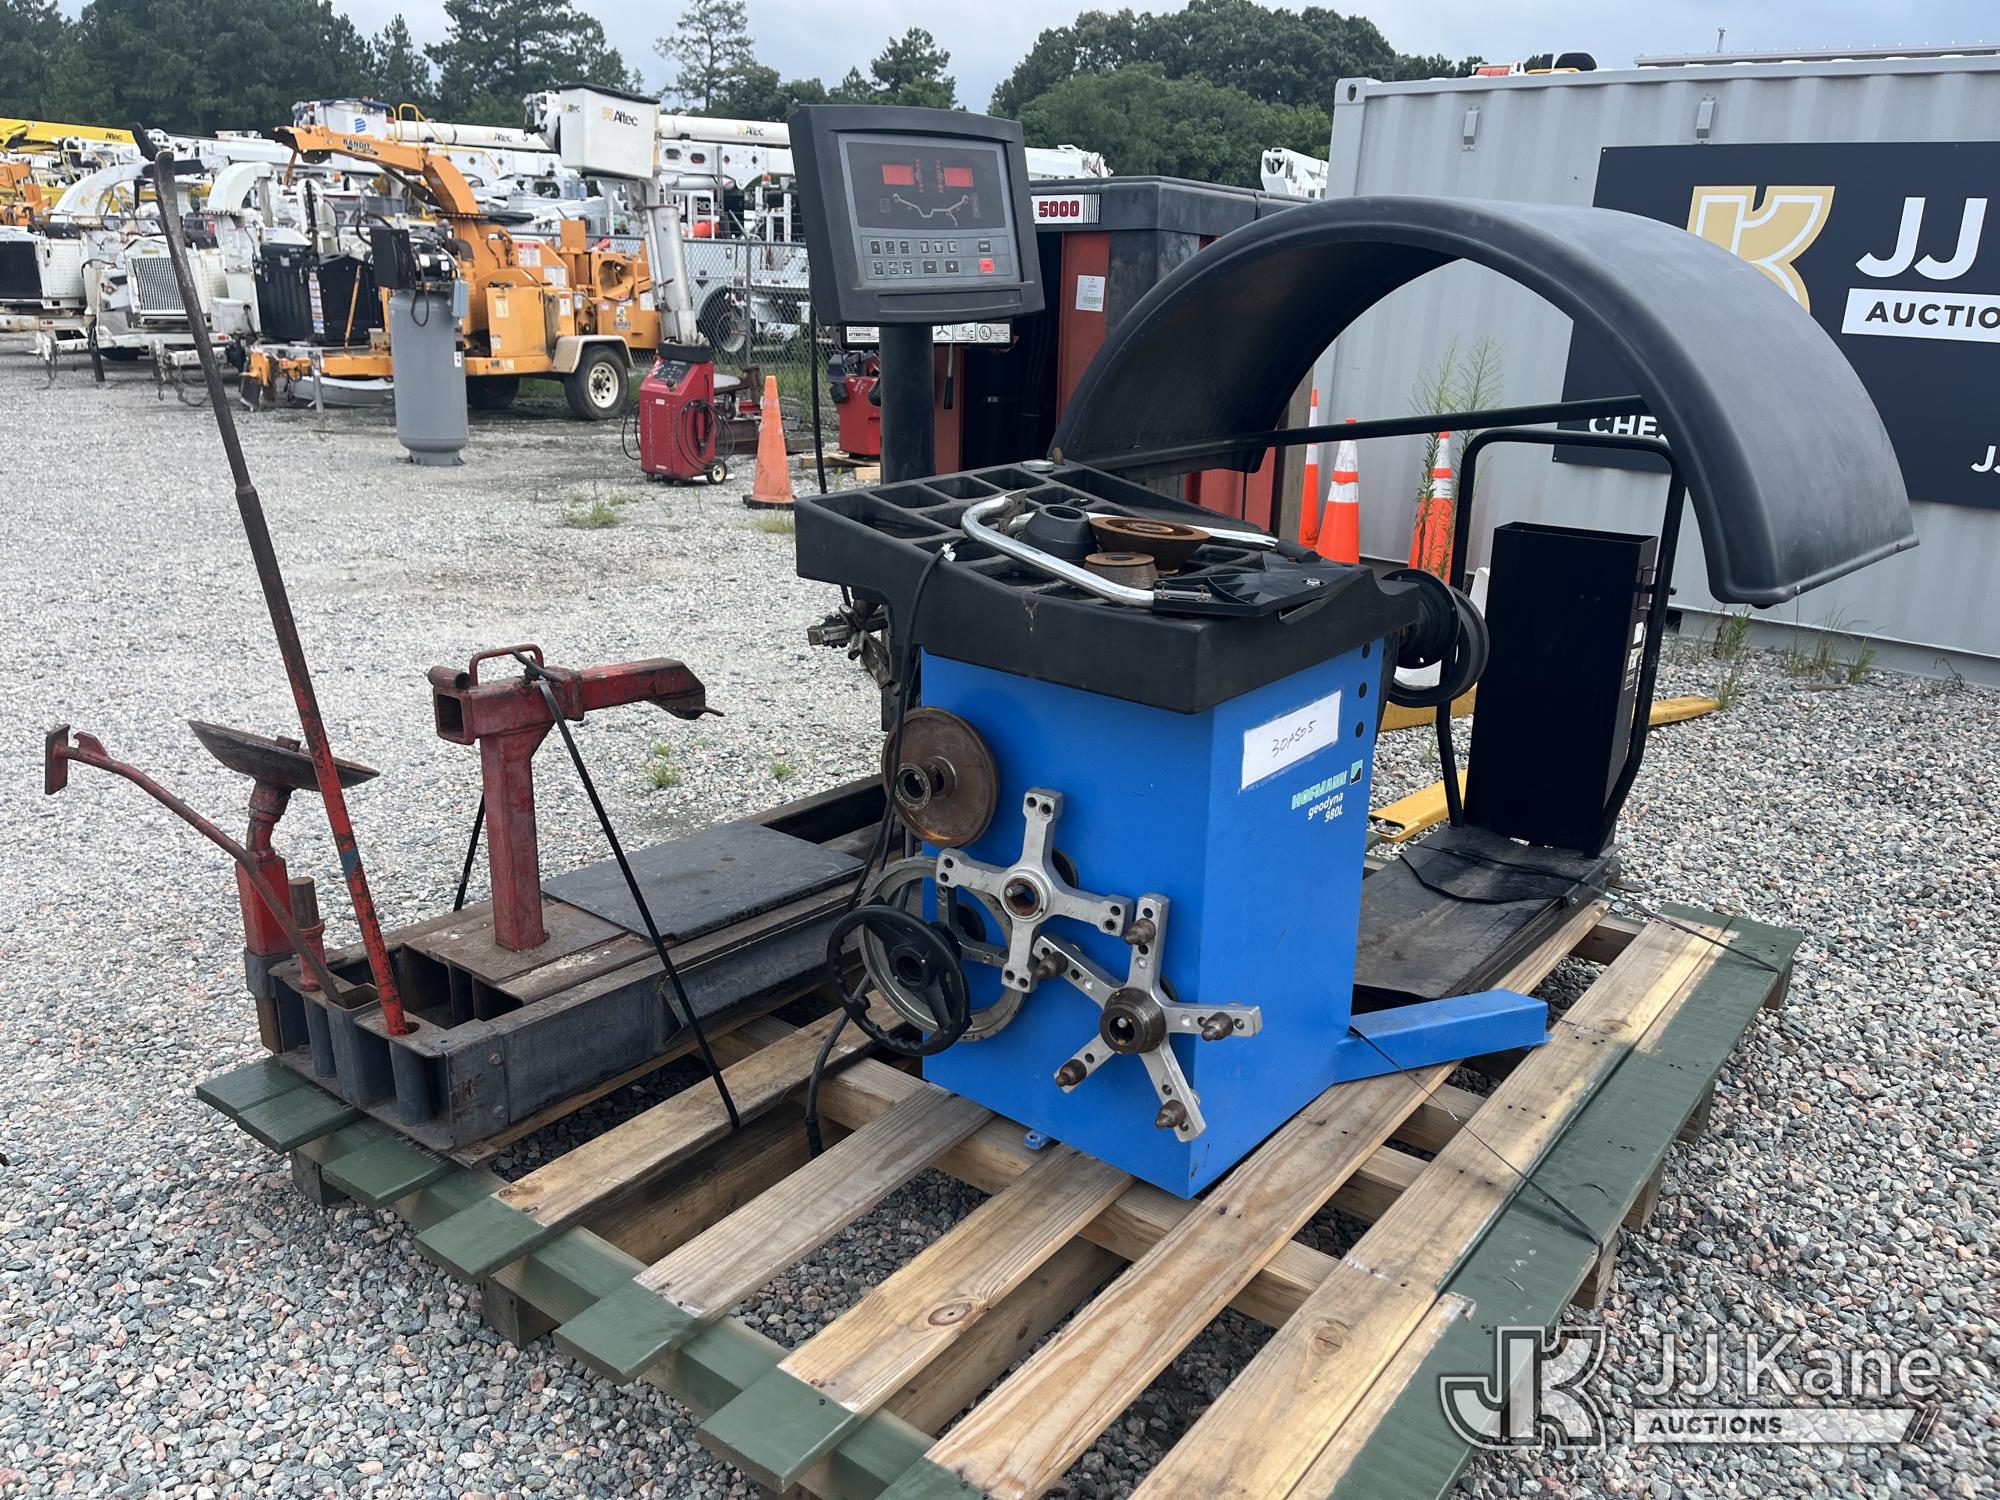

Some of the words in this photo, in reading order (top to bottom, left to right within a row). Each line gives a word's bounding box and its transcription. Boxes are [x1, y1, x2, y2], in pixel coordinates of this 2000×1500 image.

[613, 110, 638, 126] Altec
[1039, 201, 1079, 217] 5000
[1855, 197, 1988, 280] JJ
[1291, 771, 1347, 810] HOFMANN
[1308, 792, 1344, 821] geodyna
[1324, 804, 1343, 823] 980L
